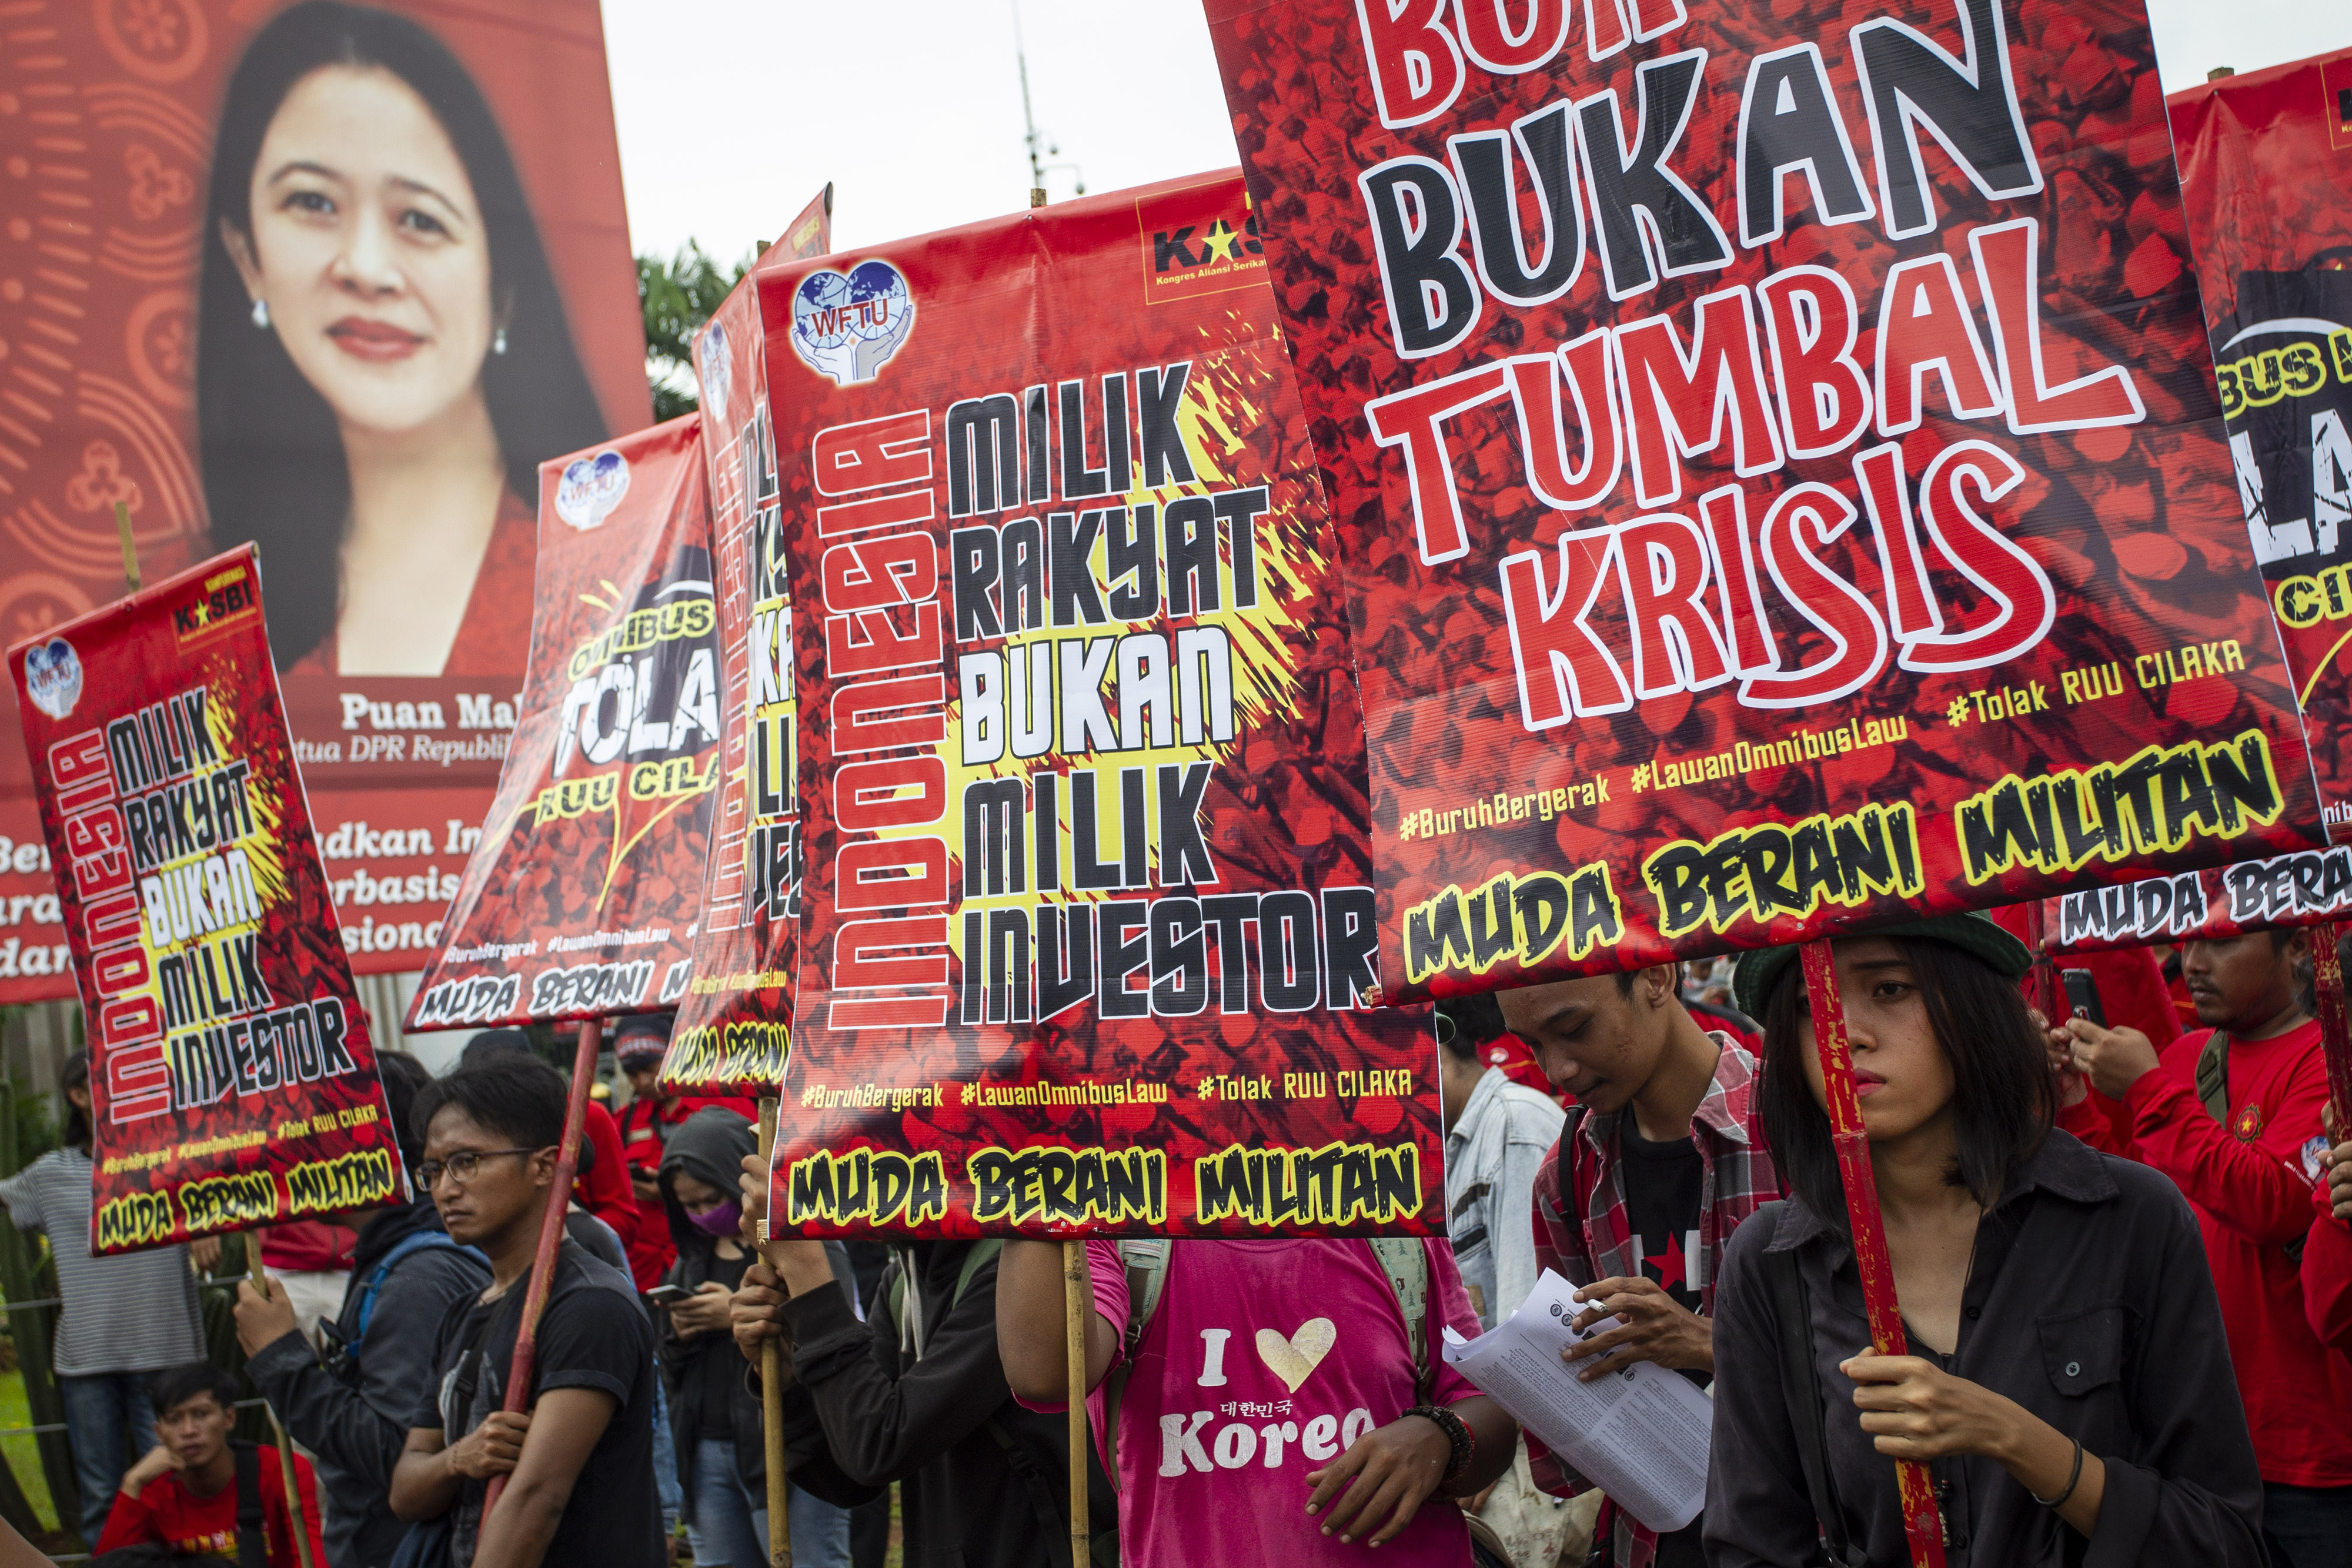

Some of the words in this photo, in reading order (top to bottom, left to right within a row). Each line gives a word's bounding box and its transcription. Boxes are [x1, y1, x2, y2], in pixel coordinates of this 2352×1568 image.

[1357, 0, 2044, 359] BUKAN
[811, 298, 888, 337] WFTU
[1156, 272, 1195, 286] Kongres
[1198, 266, 1231, 279] Aliansi
[946, 360, 1200, 520] MILIK
[1364, 217, 2147, 566] TUMBAL
[950, 486, 1270, 643] RAKYAT
[1499, 439, 2058, 732] KRISIS
[106, 686, 221, 798] MILIK
[293, 737, 342, 763] tua
[349, 735, 406, 763] DPR
[339, 693, 446, 730] Puan
[813, 408, 951, 1031] INDONESIA
[958, 624, 1235, 767] BUKAN
[1400, 773, 1611, 841] #BuruhBergerak
[1632, 714, 1908, 794] #LawanOmnibusLaw
[1946, 678, 2048, 730] #Tolak
[2062, 665, 2124, 707] RUU
[2140, 638, 2246, 691] CILAKA
[122, 758, 258, 874] RAKYAT
[963, 760, 1220, 898] MILIK
[1403, 859, 1625, 984] MUDA
[1641, 800, 1926, 939] BERANI
[1954, 728, 2286, 887] MILITAN
[48, 727, 172, 1125] INDONESIA
[141, 846, 262, 950] BUKAN
[2061, 871, 2209, 947] MUDA
[157, 930, 275, 1031] MILIK
[527, 959, 655, 1016] BERANI
[960, 887, 1381, 1026] INVESTOR
[169, 996, 358, 1111] INVESTOR
[800, 1082, 944, 1112] #BuruhBergerak
[961, 1078, 1168, 1107] #LawanOmnibusLaw
[1197, 1072, 1272, 1102] #Tolak
[1284, 1071, 1328, 1101] RUU
[1337, 1068, 1412, 1098] CILAKA
[312, 1112, 338, 1134] RUU
[338, 1104, 379, 1128] CILAKA
[98, 1189, 175, 1250] MUDA
[178, 1170, 278, 1232] BERANI
[285, 1147, 395, 1215] MILITAN
[788, 1145, 949, 1228] MUDA
[967, 1143, 1167, 1225] BERANI
[1195, 1140, 1424, 1228] MILITAN
[1197, 1328, 1232, 1387] I
[1220, 1399, 1294, 1418] 대한민국
